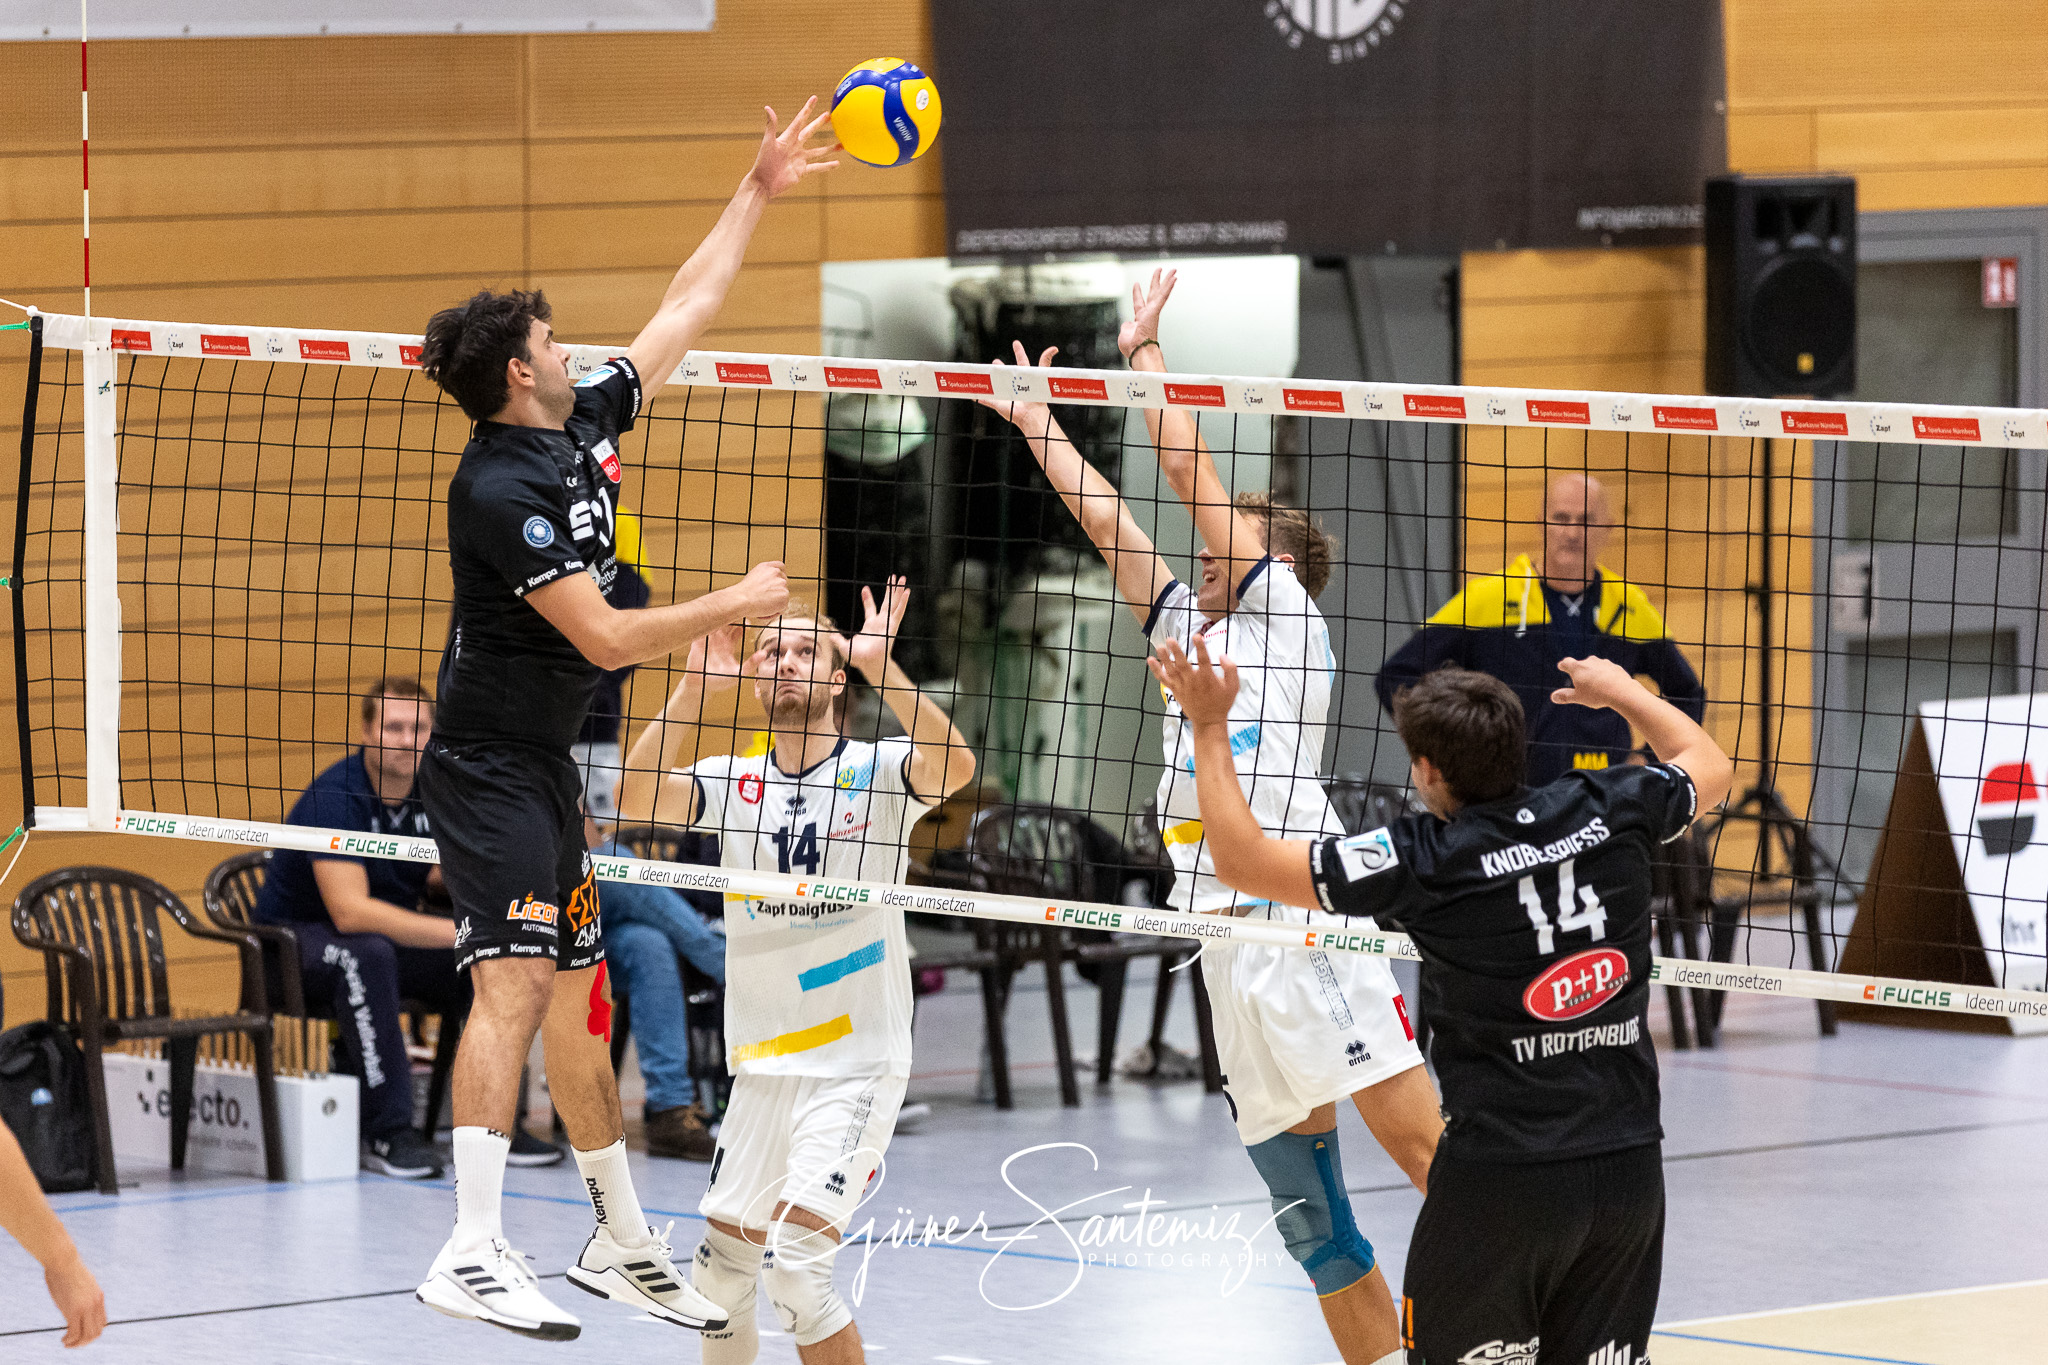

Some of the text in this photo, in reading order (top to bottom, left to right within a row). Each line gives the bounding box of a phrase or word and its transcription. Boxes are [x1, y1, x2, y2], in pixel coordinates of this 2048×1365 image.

[172, 341, 184, 349] Zapf
[211, 343, 230, 351] Sparkasse
[271, 346, 283, 354] Zapf
[309, 348, 329, 356] Sparkasse
[372, 351, 383, 359] Zapf
[579, 364, 592, 373] Zapf
[614, 359, 635, 379] Kemp
[686, 369, 699, 378] Zapf
[728, 371, 748, 379] Sparkasse
[795, 375, 808, 383] Zapf
[837, 375, 857, 383] Sparkasse
[904, 379, 918, 388] Zapf
[1017, 384, 1030, 393] Zapf
[1061, 386, 1082, 394] Sparkasse
[1132, 390, 1146, 399] Zapf
[1177, 392, 1199, 400] Sparkasse
[1250, 397, 1263, 405] Zapf
[1296, 398, 1319, 406] Sparkasse
[1369, 402, 1383, 411] Zapf
[1418, 404, 1439, 412] Sparkasse
[1493, 408, 1506, 417] Zapf
[1540, 410, 1562, 418] Sparkasse
[1617, 413, 1632, 422] Zapf
[1667, 416, 1690, 424] Sparkasse
[1745, 419, 1760, 428] Zapf
[1796, 421, 1820, 429] Sparkasse
[1875, 424, 1891, 433] Zapf
[1927, 425, 1952, 433] Sparkasse
[2010, 430, 2025, 439] Zapf
[527, 567, 558, 588] Kempa
[126, 818, 269, 843] FUCHS Ideen umsetzen
[345, 838, 438, 860] FUCHS Ideen
[772, 822, 820, 876] 14
[594, 862, 629, 879] CHS
[639, 866, 670, 882] Ideen
[673, 871, 729, 888] umsetzen
[813, 884, 975, 913] FUCHS Ideen umsetzen
[757, 900, 786, 918] Zapf
[1518, 858, 1608, 955] 14
[1062, 909, 1232, 939] FUCHS Ideen umsetzen
[510, 943, 542, 955] Kempa
[1323, 934, 1422, 957] FUCHS Ide
[570, 956, 591, 967] Kempa
[1674, 967, 1711, 985] Ideen
[1715, 973, 1782, 991] umsetzen
[1551, 958, 1613, 1013] p+p
[1883, 987, 2048, 1016] FUCHS Ideen umse
[1511, 1036, 1536, 1063] TV
[1349, 1053, 1371, 1067] errea
[157, 1089, 249, 1130] ecto.
[825, 1183, 844, 1196] errea
[586, 1177, 609, 1225] Kempa
